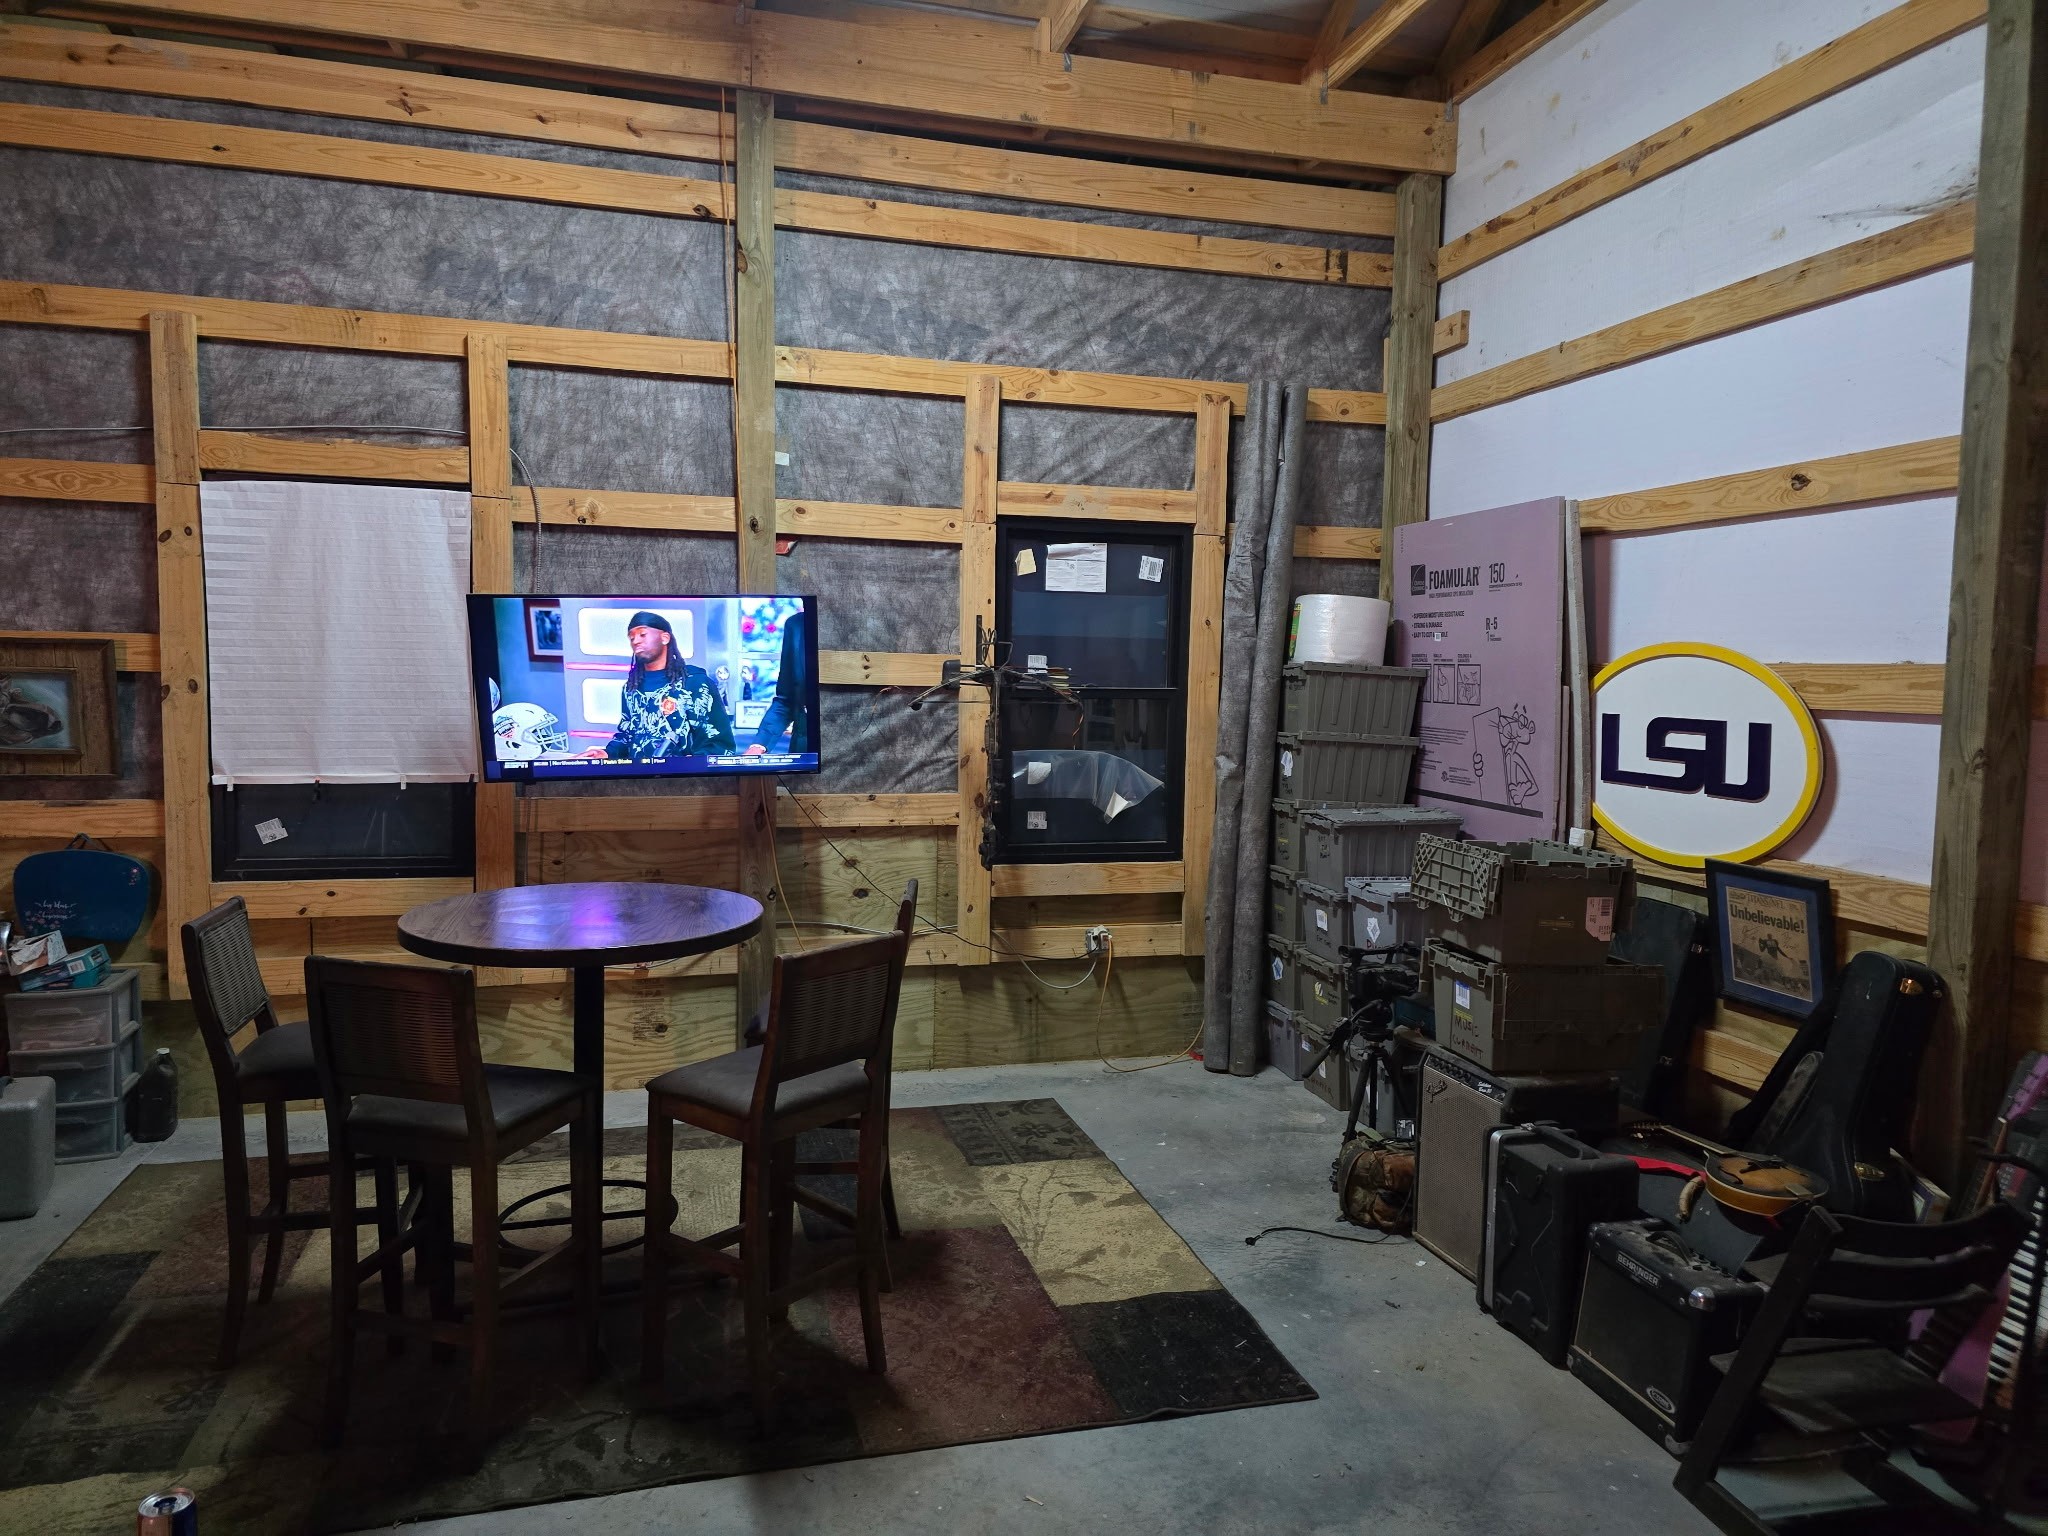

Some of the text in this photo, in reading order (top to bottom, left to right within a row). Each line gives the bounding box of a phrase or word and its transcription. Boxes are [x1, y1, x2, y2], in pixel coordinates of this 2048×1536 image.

[1429, 563, 1505, 590] FOAMULAR 150
[1485, 617, 1498, 630] R-5
[1601, 713, 1772, 802] LSU
[1730, 904, 1805, 934] Unbelievable!
[1455, 1015, 1479, 1038] MUSIC
[1617, 1254, 1659, 1286] BEHRINGER
